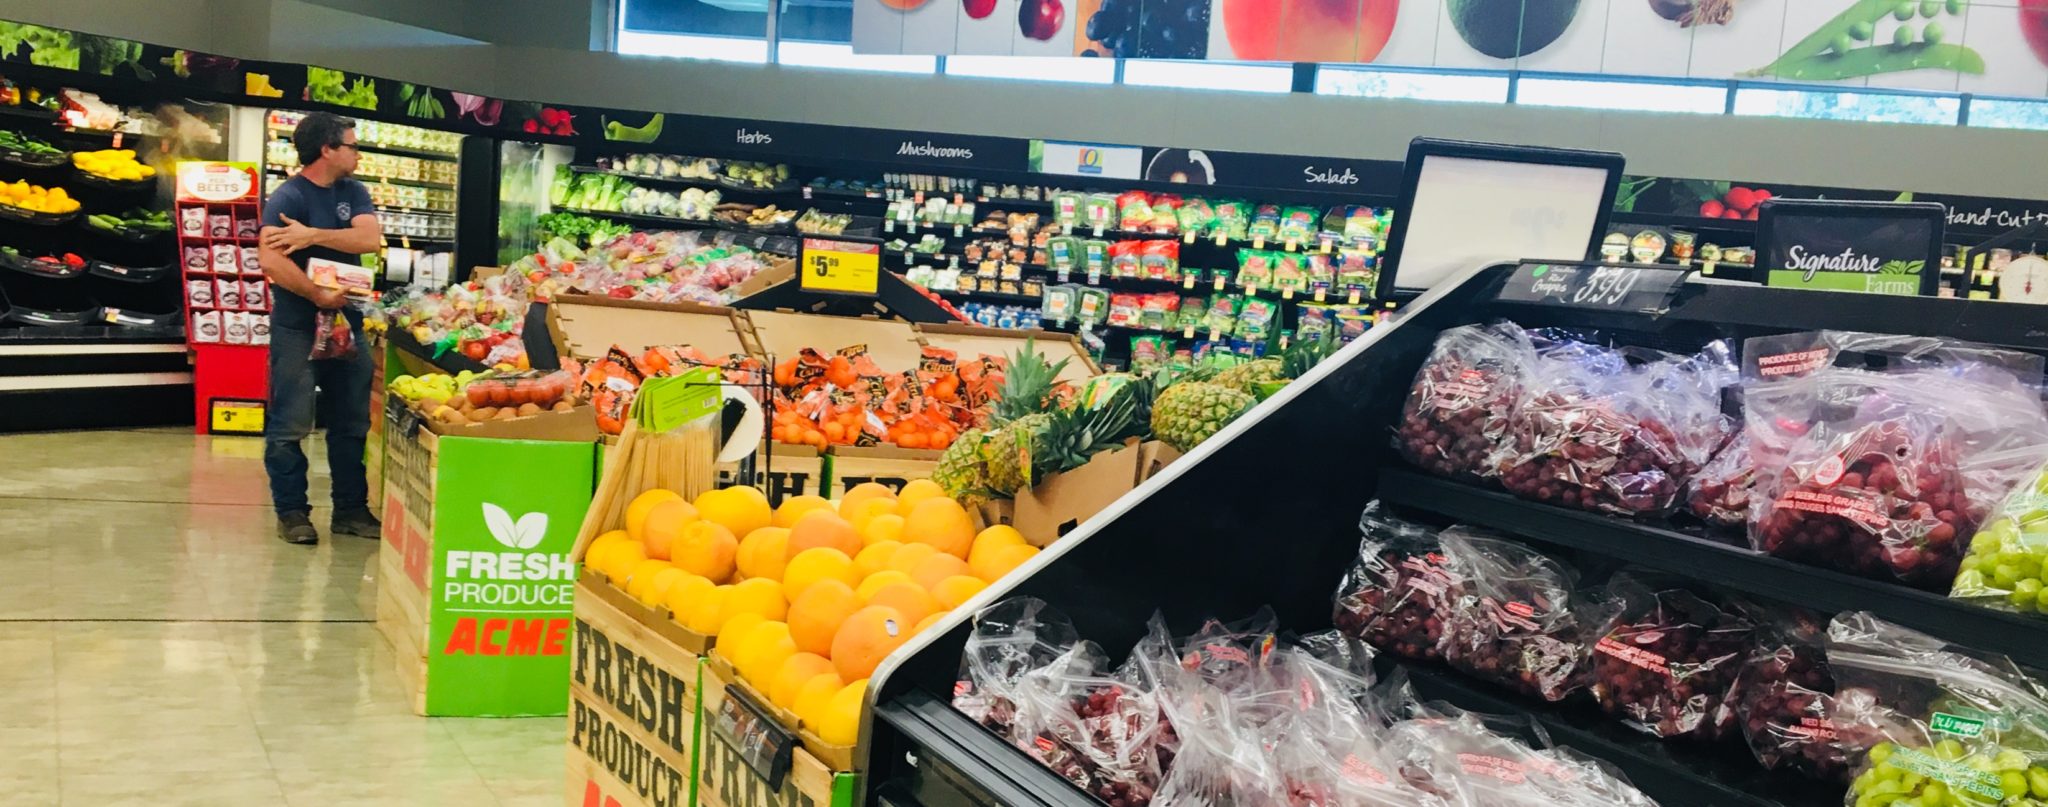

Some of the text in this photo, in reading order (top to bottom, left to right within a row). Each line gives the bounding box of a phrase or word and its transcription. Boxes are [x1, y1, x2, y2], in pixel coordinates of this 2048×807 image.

[736, 128, 772, 144] Herbs
[897, 141, 973, 159] Mushrooms
[1303, 166, 1359, 185] Salads
[197, 183, 239, 192] BEETS
[1785, 245, 1882, 282] Signature
[1865, 273, 1914, 294] Farms
[445, 550, 575, 581] FRESH
[444, 582, 574, 605] PRODUCE
[444, 617, 571, 657] ACME
[574, 617, 685, 755] FRESH
[573, 698, 683, 807] PRODUCE
